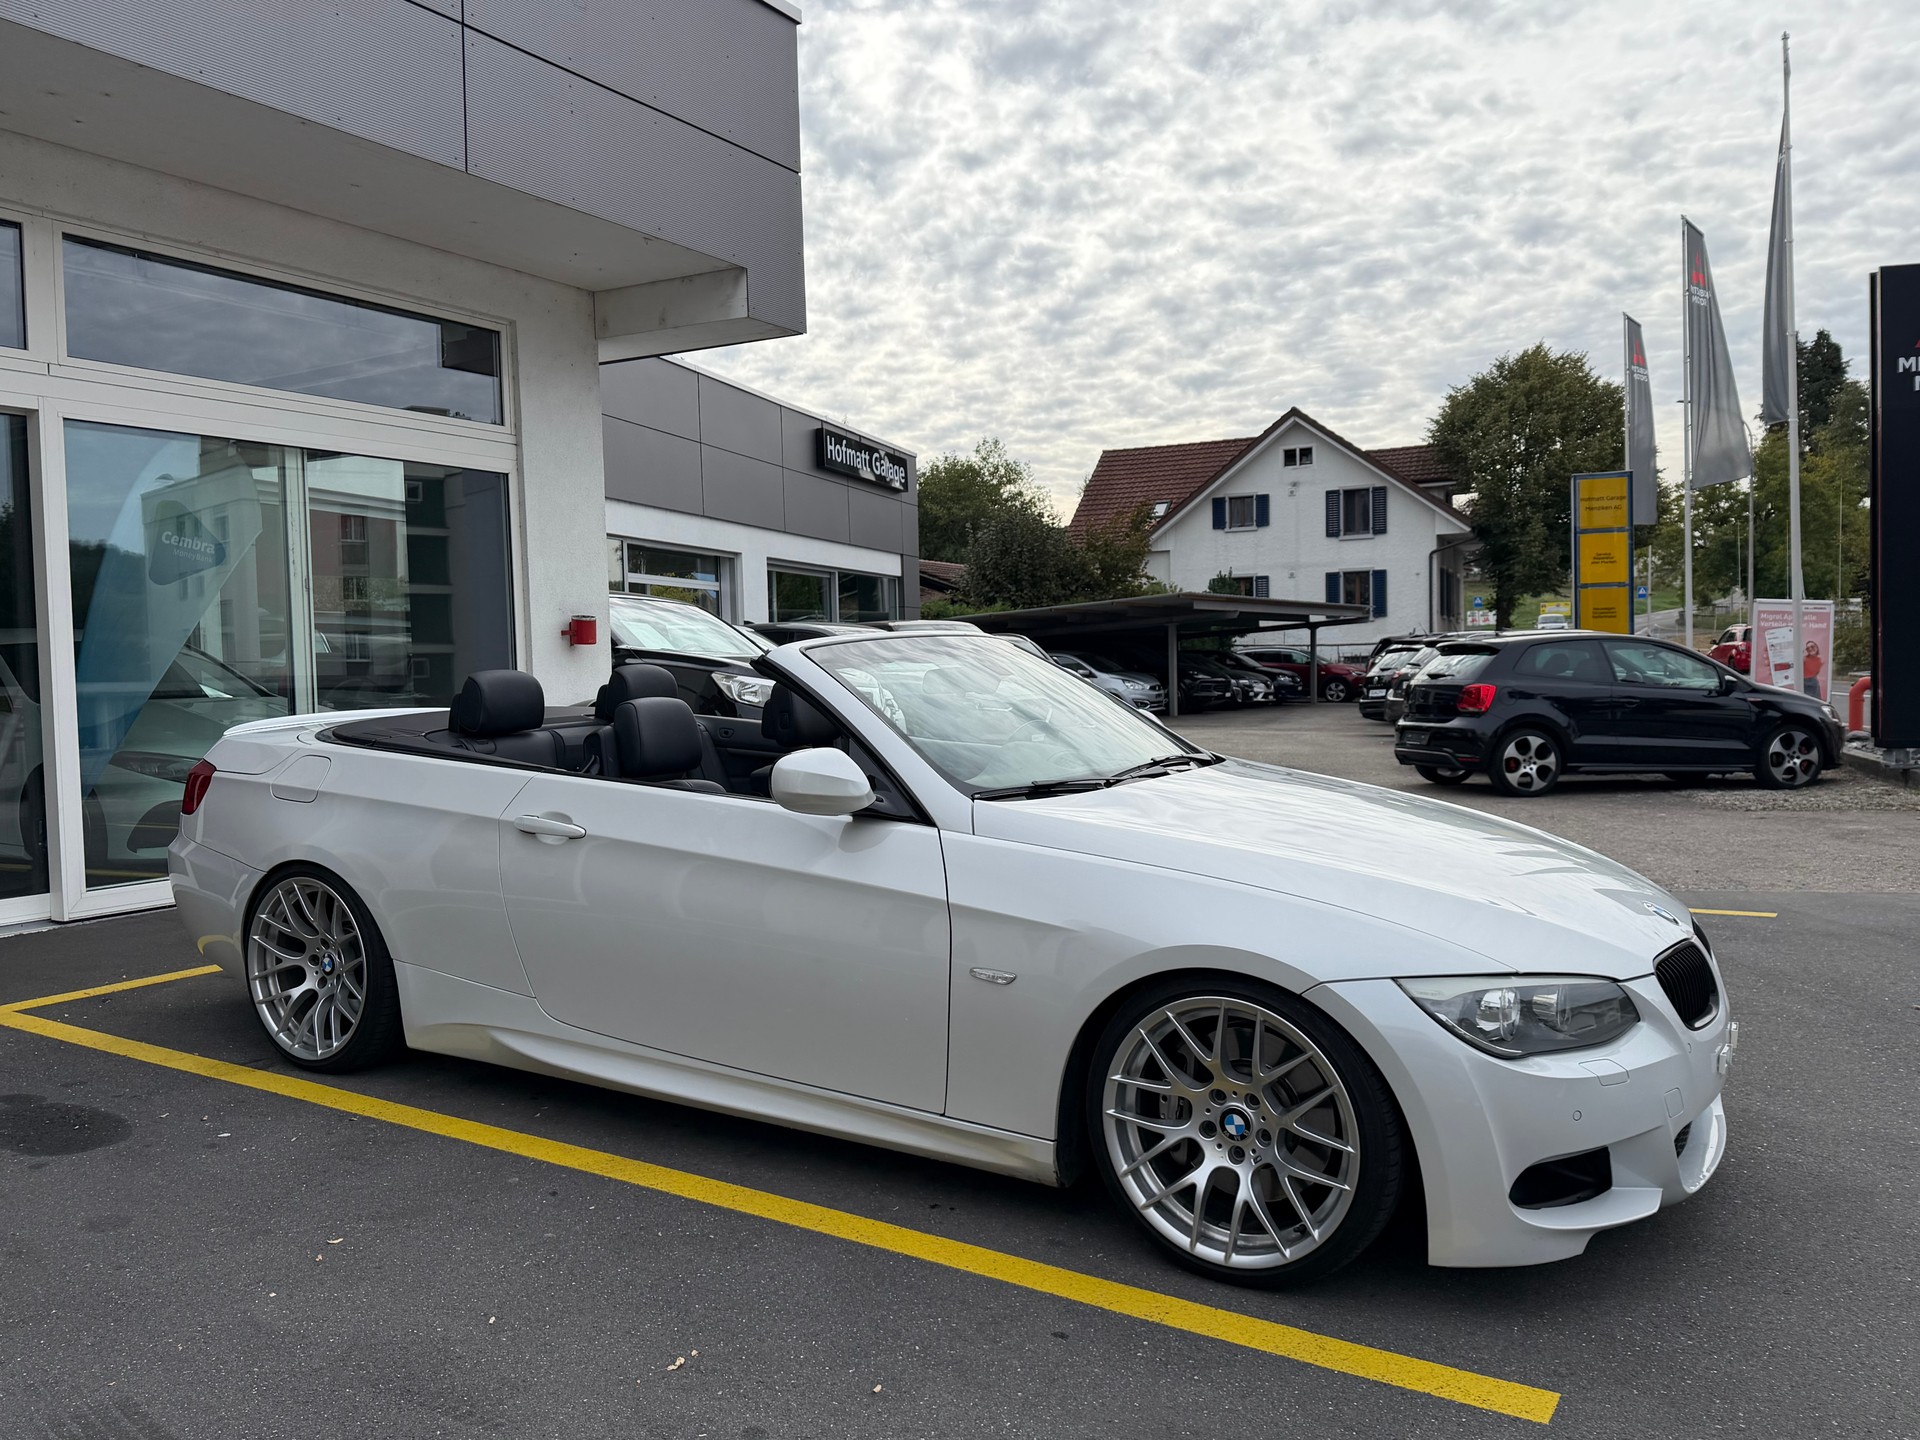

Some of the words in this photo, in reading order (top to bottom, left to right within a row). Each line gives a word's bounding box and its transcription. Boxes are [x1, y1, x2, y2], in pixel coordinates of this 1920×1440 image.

[826, 435, 871, 472] Hofmatt
[872, 452, 906, 486] Garage
[161, 530, 215, 555] Cembra
